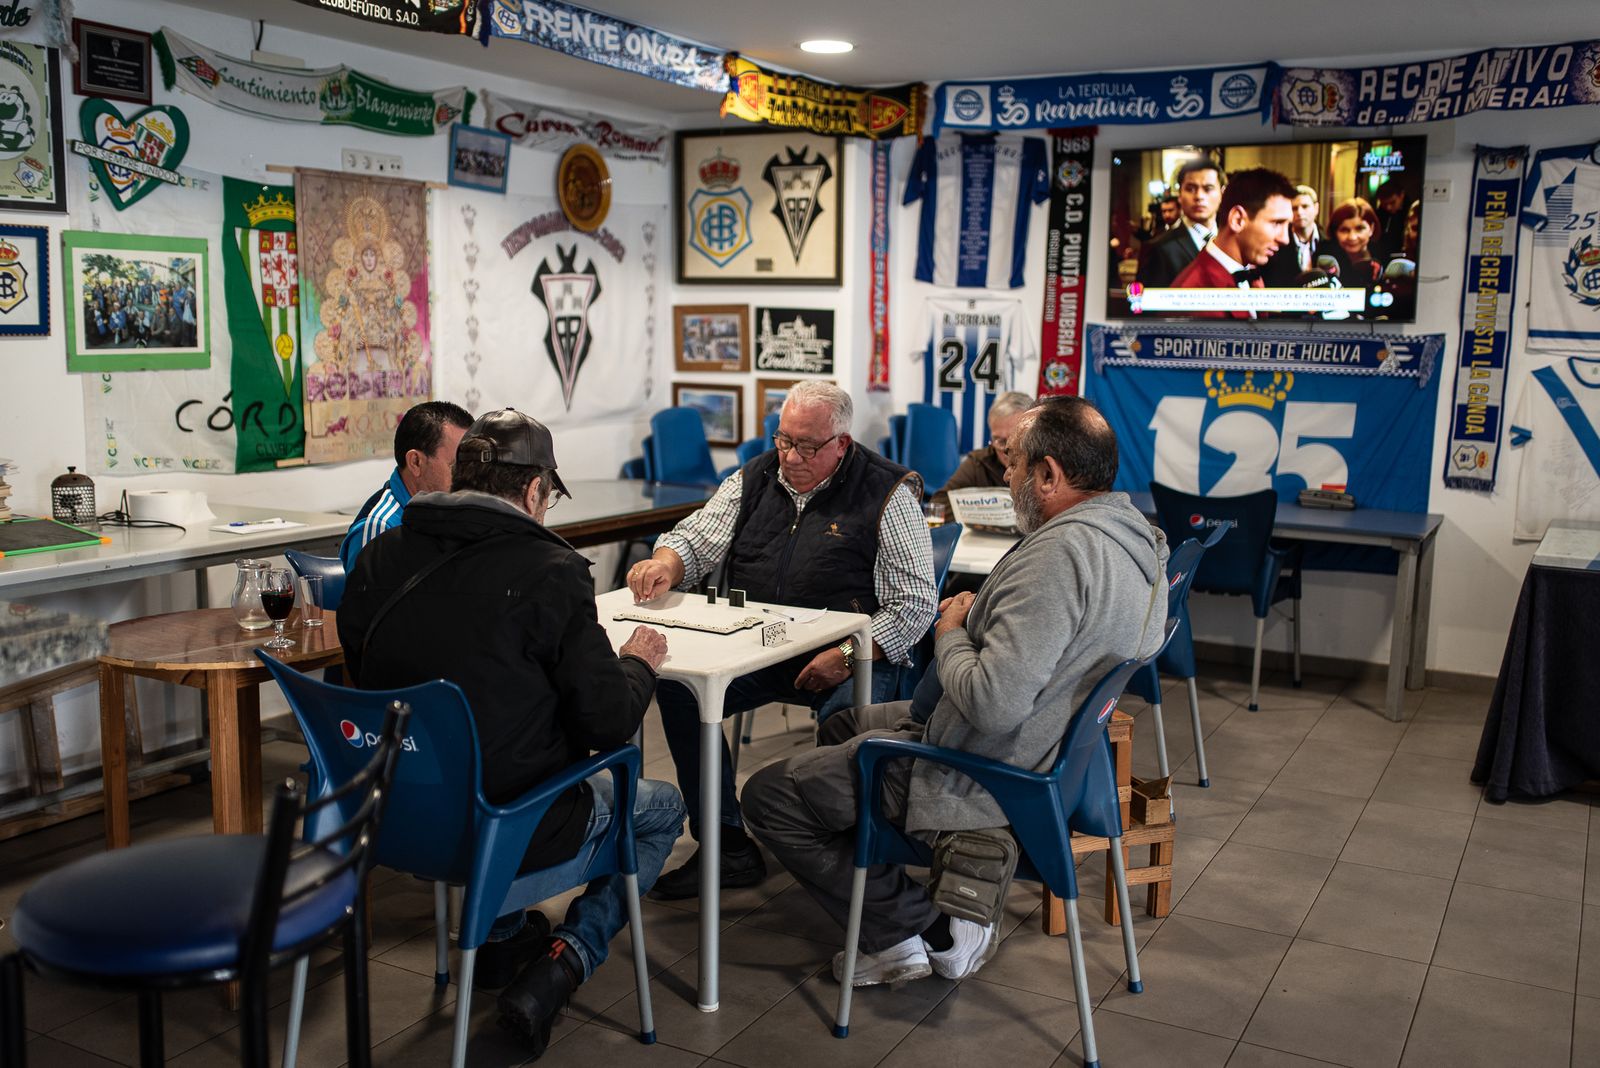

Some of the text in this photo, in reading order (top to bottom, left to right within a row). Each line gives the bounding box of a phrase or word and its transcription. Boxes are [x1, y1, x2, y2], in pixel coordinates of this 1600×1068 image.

[395, 10, 420, 26] S.A.D.
[522, 0, 621, 52] FRENTE
[624, 32, 701, 74] ONUBA
[1058, 82, 1136, 99] LA TERTULIA
[1359, 46, 1574, 102] RECREATIVO
[355, 84, 433, 127] Blanquiverde
[1034, 95, 1160, 124] Recreativista
[1412, 83, 1569, 122] PRIMERA!!
[76, 142, 177, 182] POR SIEMPRE UNIDOS
[1056, 136, 1091, 153] 1968
[1056, 192, 1085, 357] C.D. PUNTA UMBRÍA
[1464, 190, 1509, 435] PEÑA RECREATIVISTA LA CANOA
[938, 336, 1001, 394] 24
[1153, 337, 1362, 363] SPORTING CLUB DE HUELVA
[1147, 395, 1358, 498] 125
[956, 496, 999, 506] Huelva
